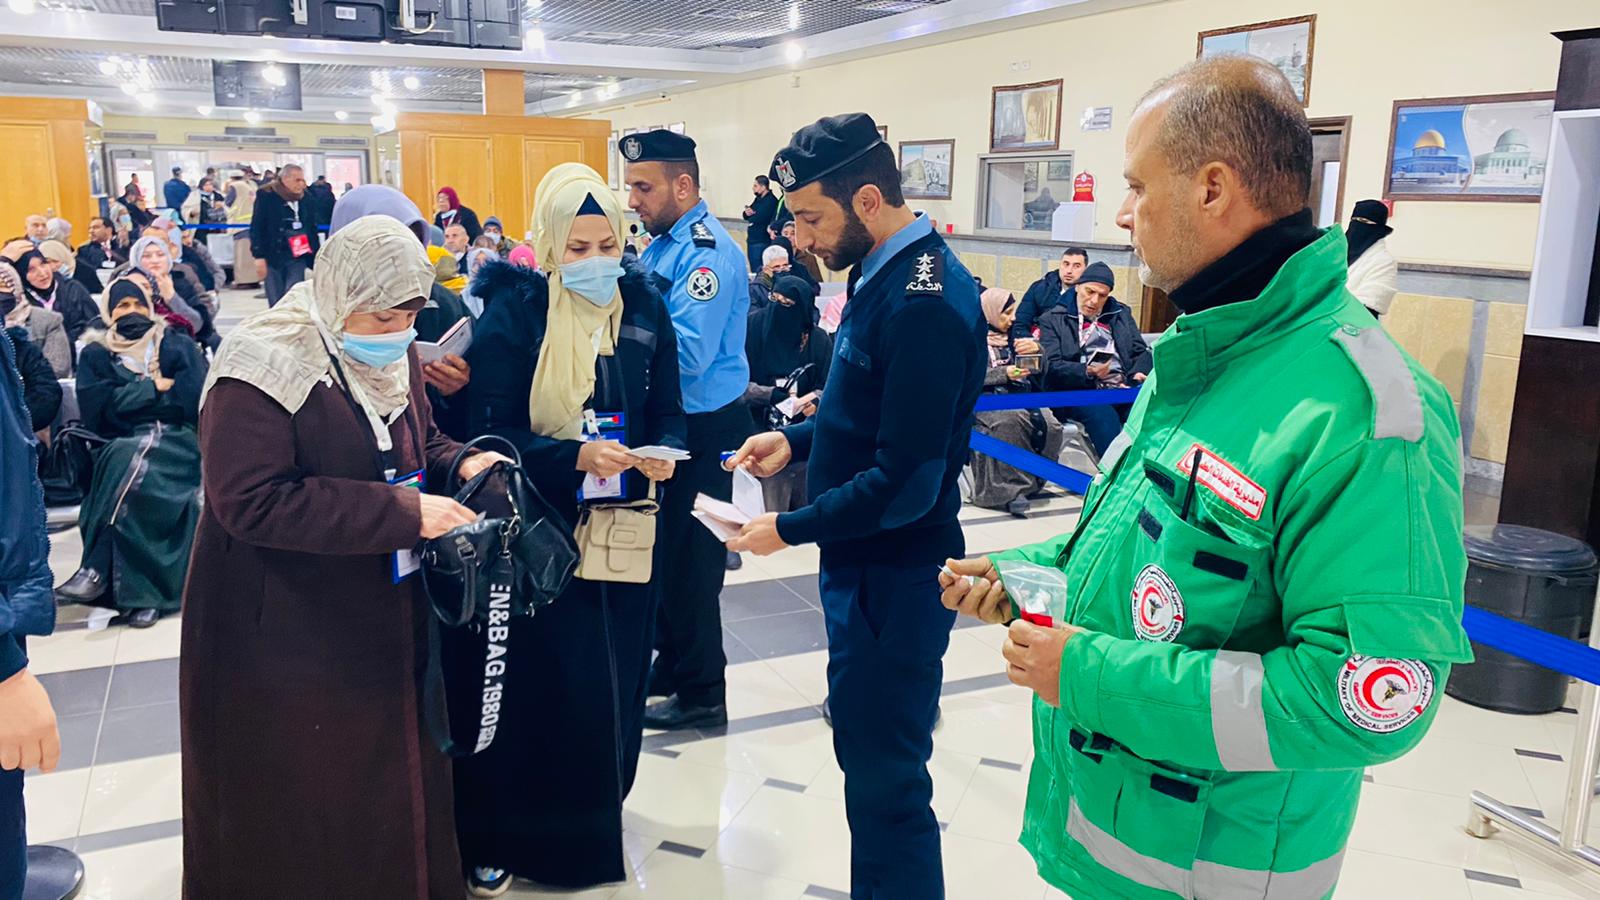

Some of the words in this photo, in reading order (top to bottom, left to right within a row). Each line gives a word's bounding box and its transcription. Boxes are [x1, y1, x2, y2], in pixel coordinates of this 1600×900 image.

[1233, 483, 1259, 507] مديرية
[1341, 670, 1352, 700] MILITARY
[1345, 702, 1354, 712] OF
[1370, 711, 1399, 719] SERVICES
[1351, 712, 1381, 729] MEDICAL
[1383, 710, 1416, 730] SERVICES
